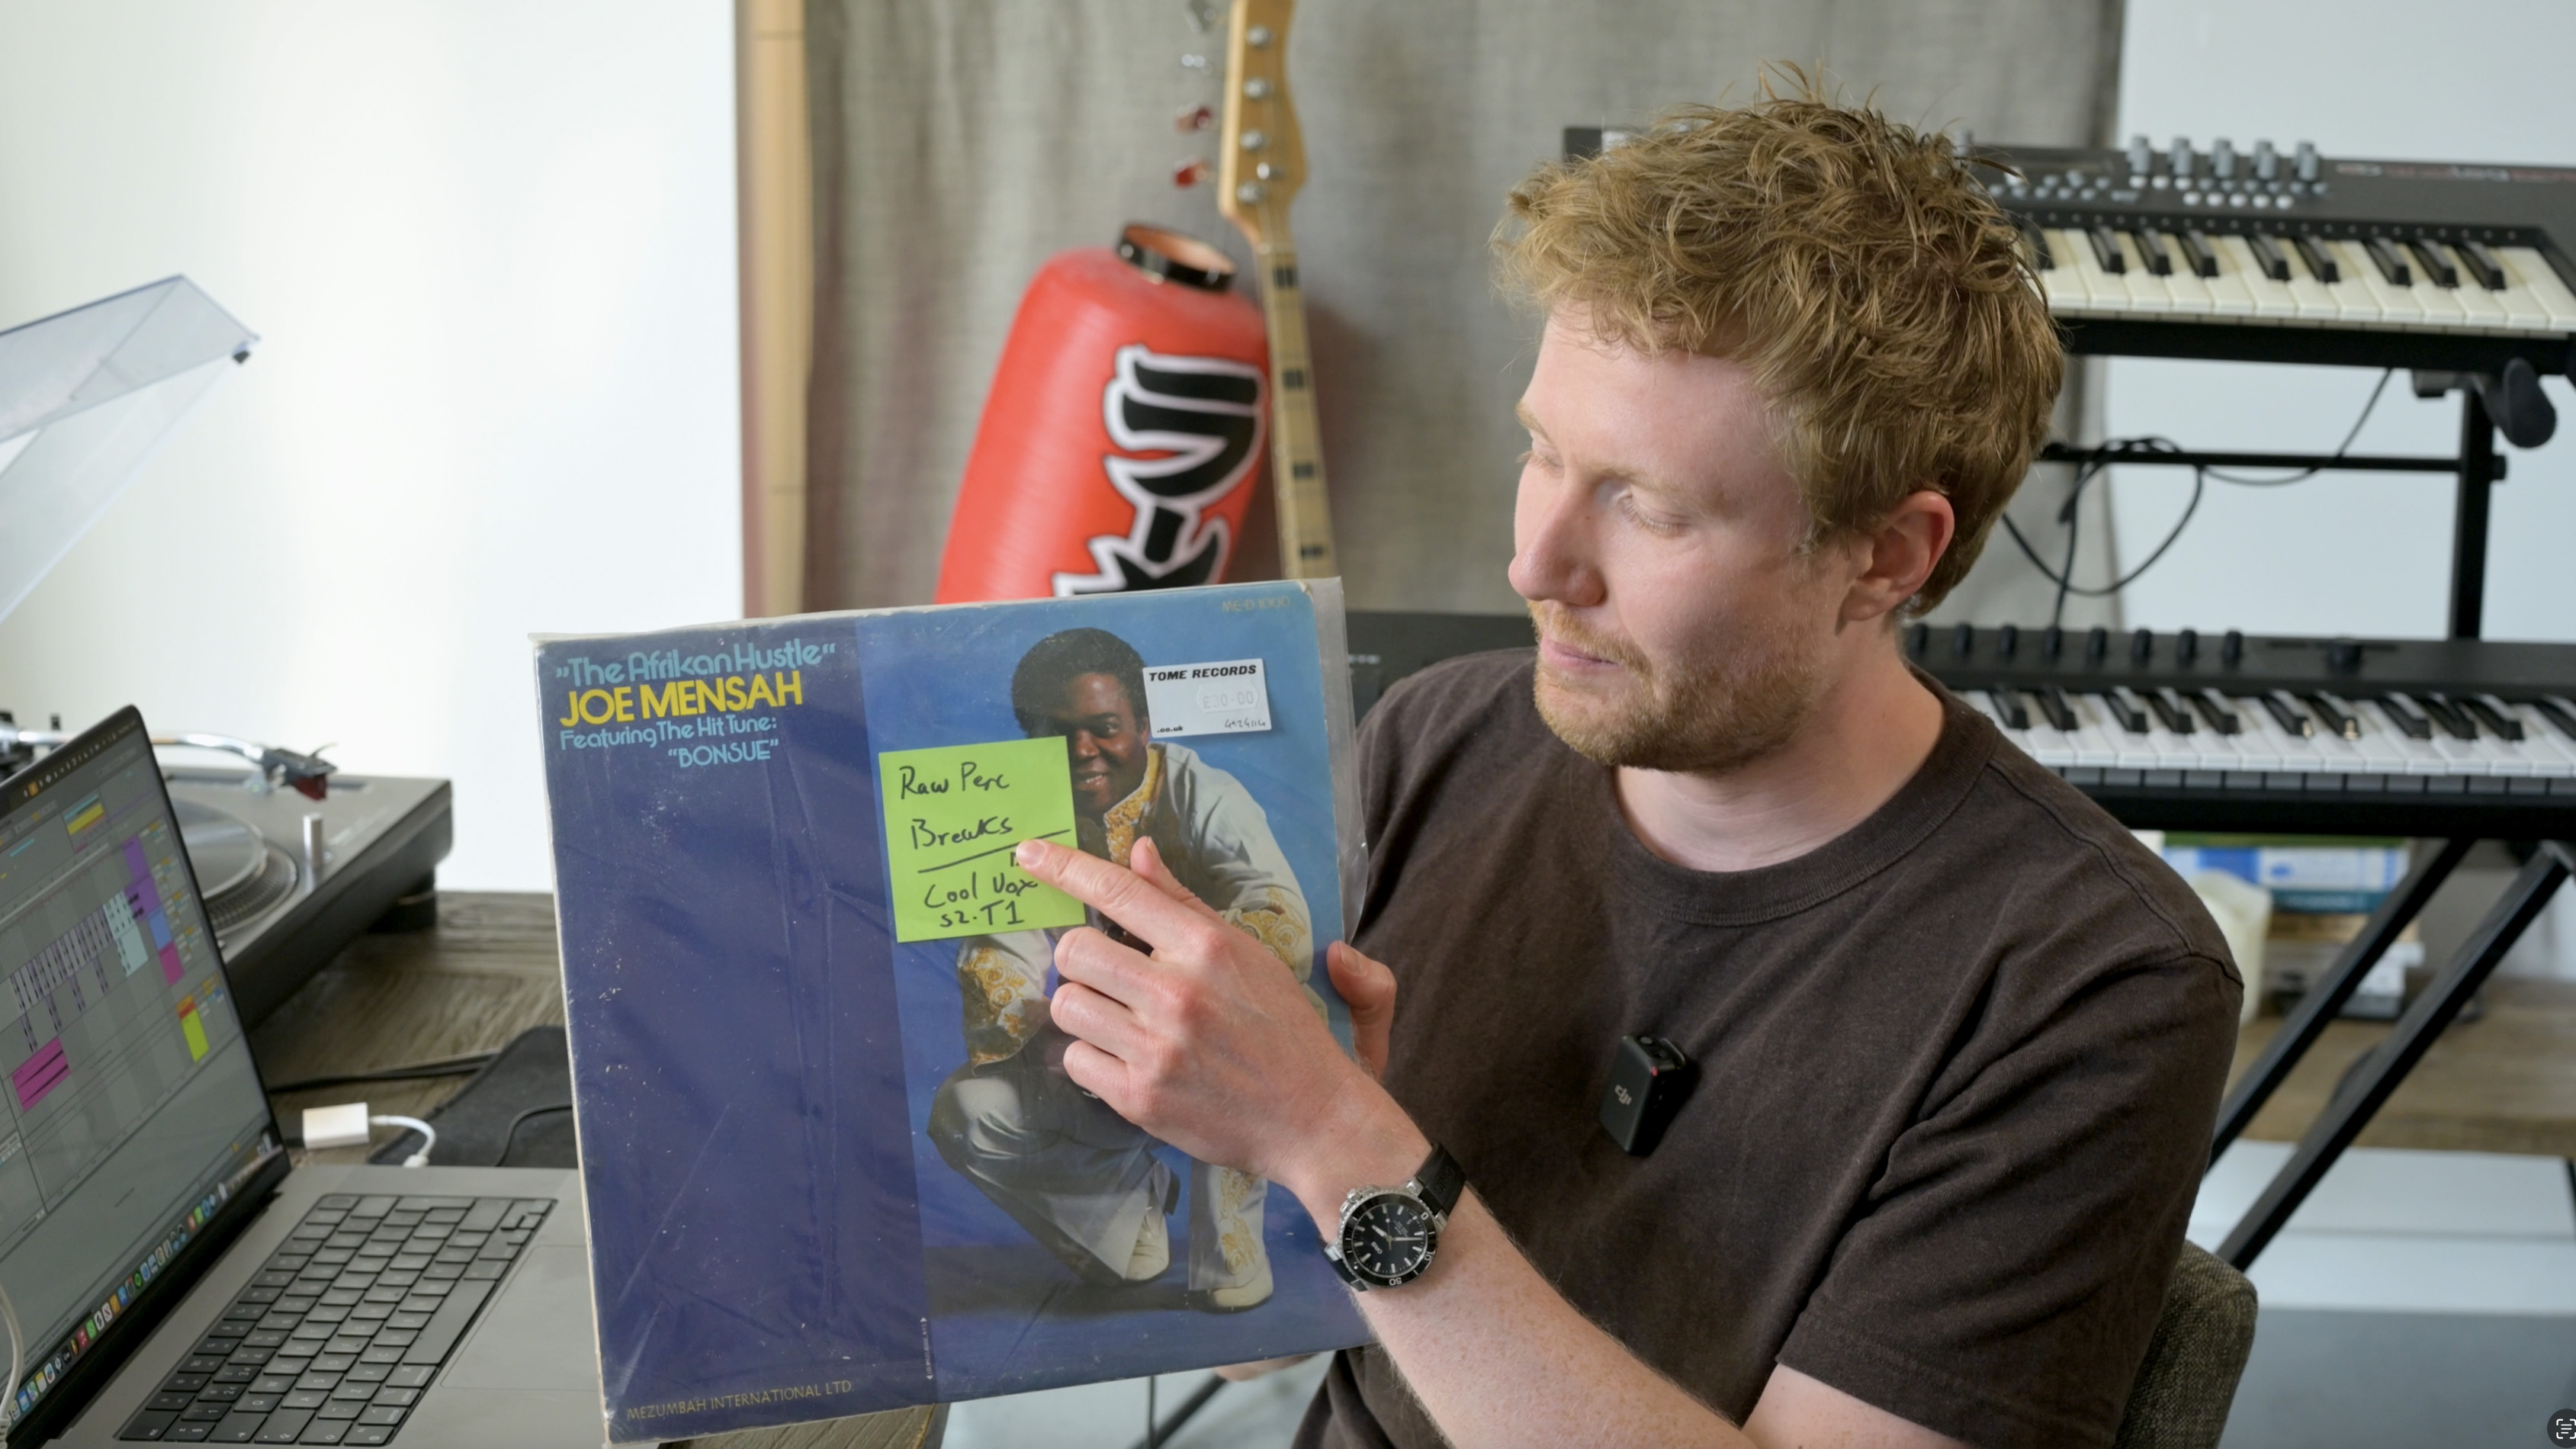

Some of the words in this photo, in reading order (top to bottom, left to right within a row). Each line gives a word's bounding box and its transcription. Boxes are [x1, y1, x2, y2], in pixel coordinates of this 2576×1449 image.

[628, 647, 731, 682] Afrikan
[1149, 670, 1187, 682] TOME
[1192, 664, 1257, 679] RECORDS
[560, 686, 635, 727] JOE
[641, 670, 802, 720] MENSAH
[560, 724, 657, 750] Featuring
[657, 719, 695, 741] The
[697, 716, 724, 738] Hit
[725, 714, 776, 734] Tune:
[899, 766, 949, 799] Raw
[961, 762, 1010, 791] Perc
[911, 816, 1013, 850] Breaks
[924, 872, 978, 908] Cool
[1389, 1277, 1402, 1286] 50
[627, 1399, 705, 1421] MEZUMBAH
[711, 1384, 821, 1409] INTERNATIONAL
[825, 1380, 854, 1394] LTD.
